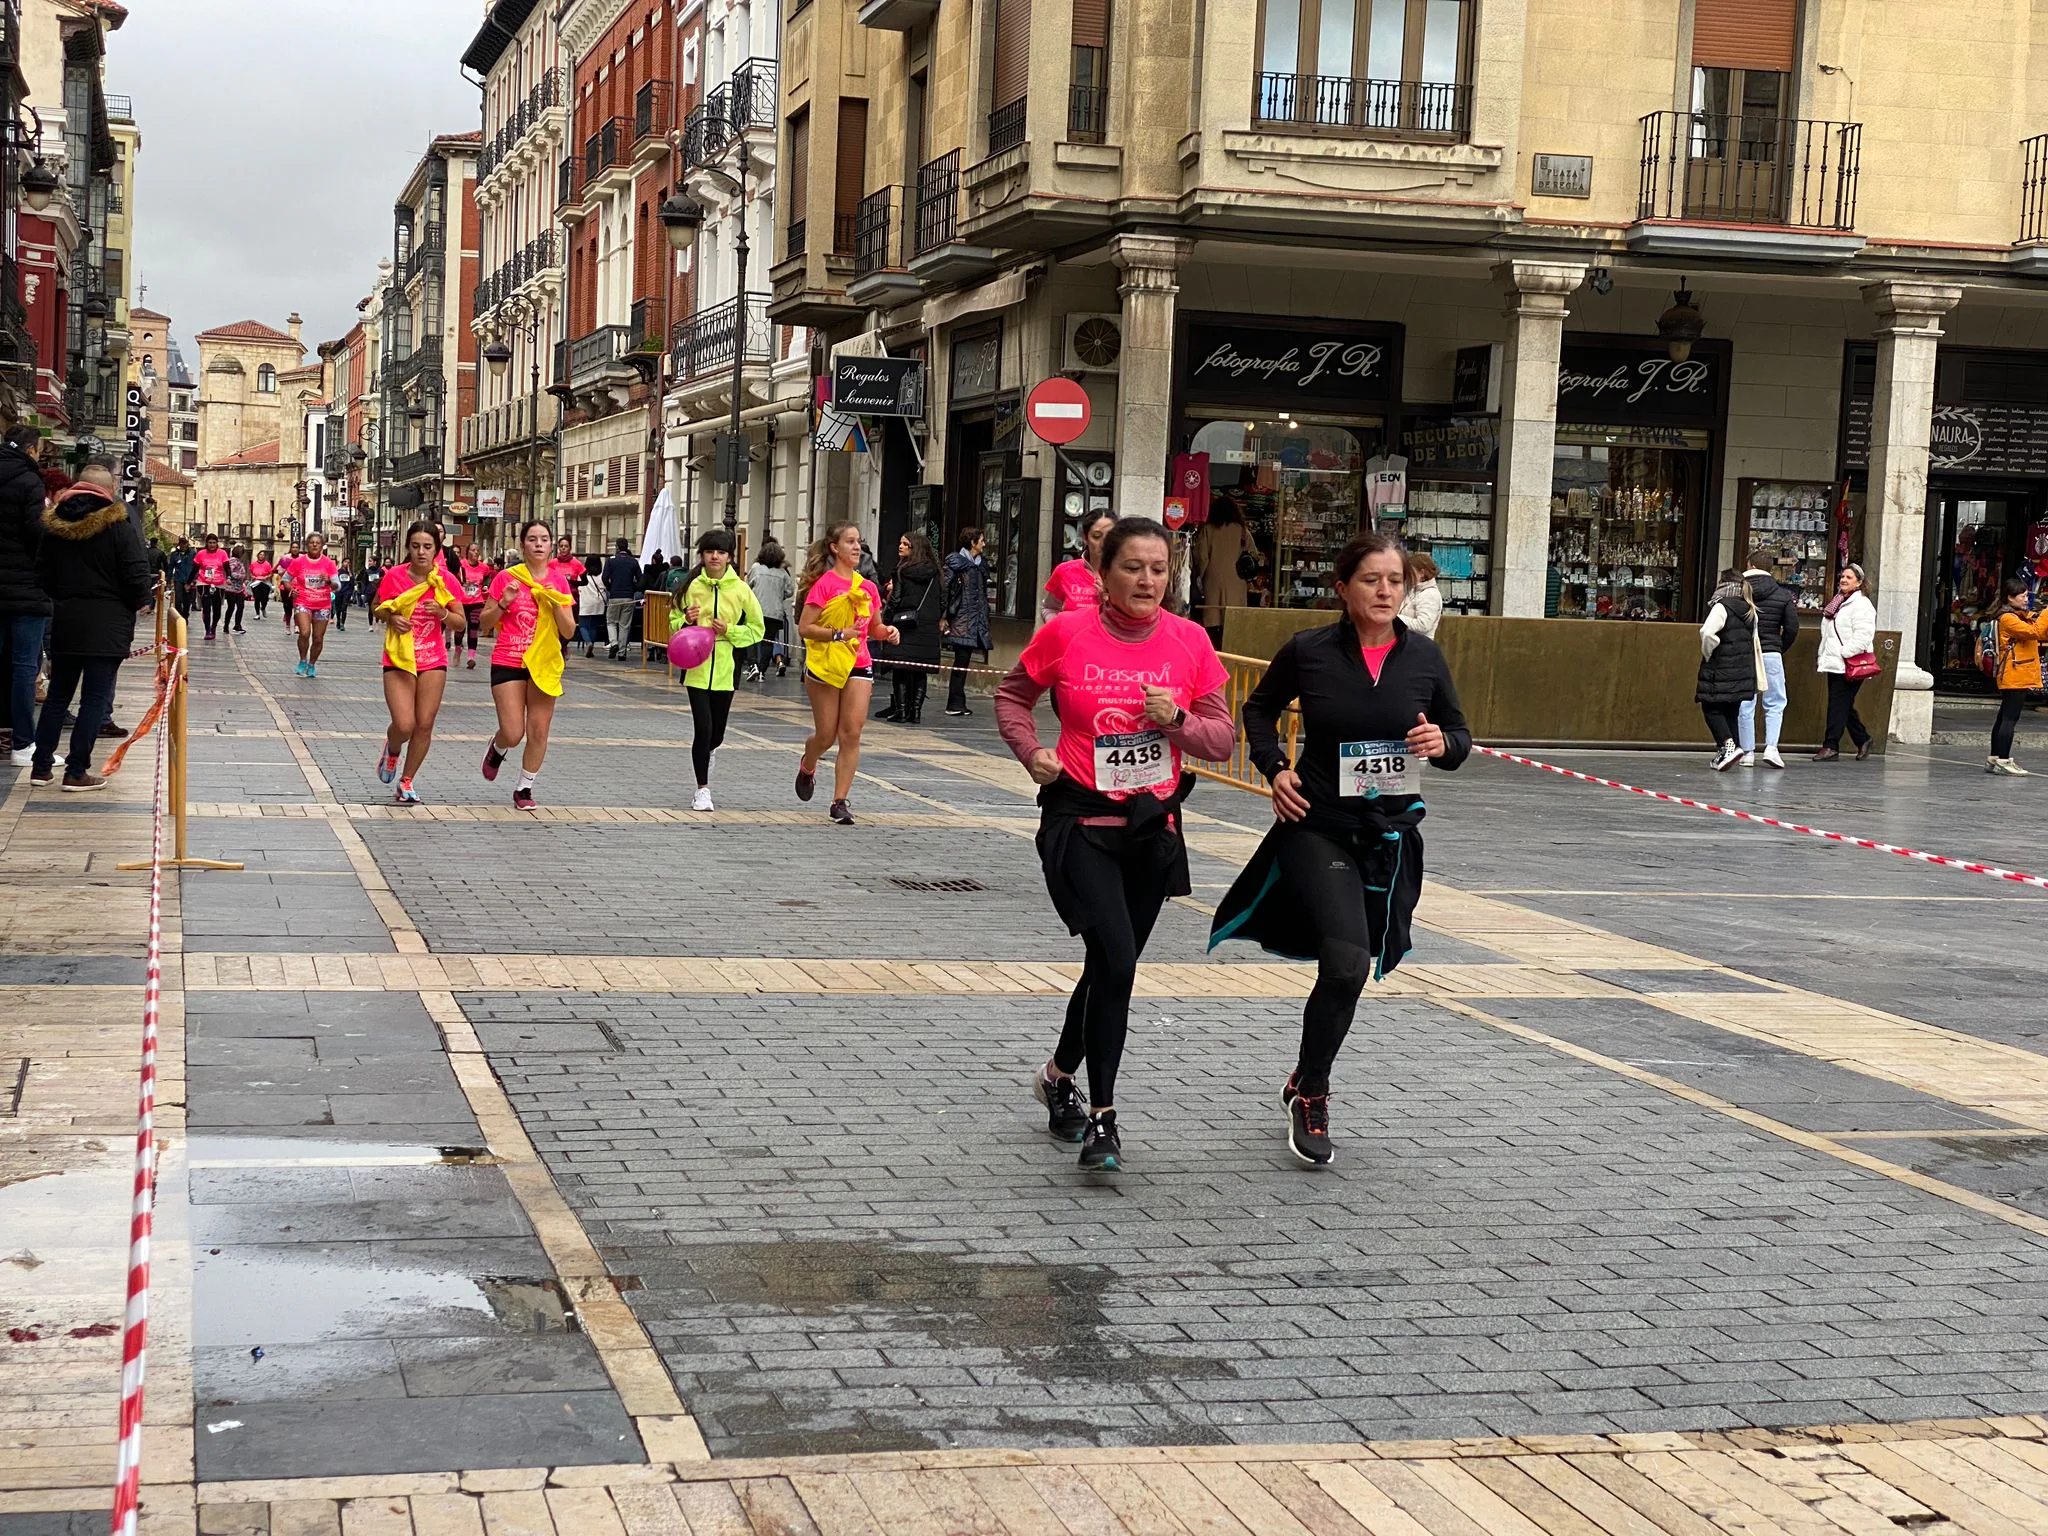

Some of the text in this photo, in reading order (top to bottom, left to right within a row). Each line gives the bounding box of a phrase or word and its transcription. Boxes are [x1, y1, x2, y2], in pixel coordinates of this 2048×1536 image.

[1547, 169, 1578, 178] PLAZA
[839, 365, 890, 386] Regalos
[1559, 365, 1630, 398] tografia
[839, 389, 895, 406] Souvenir
[1413, 446, 1437, 463] DE
[1084, 661, 1172, 683] Drasanvi
[1106, 743, 1162, 767] 4438
[1353, 756, 1406, 774] 4318
